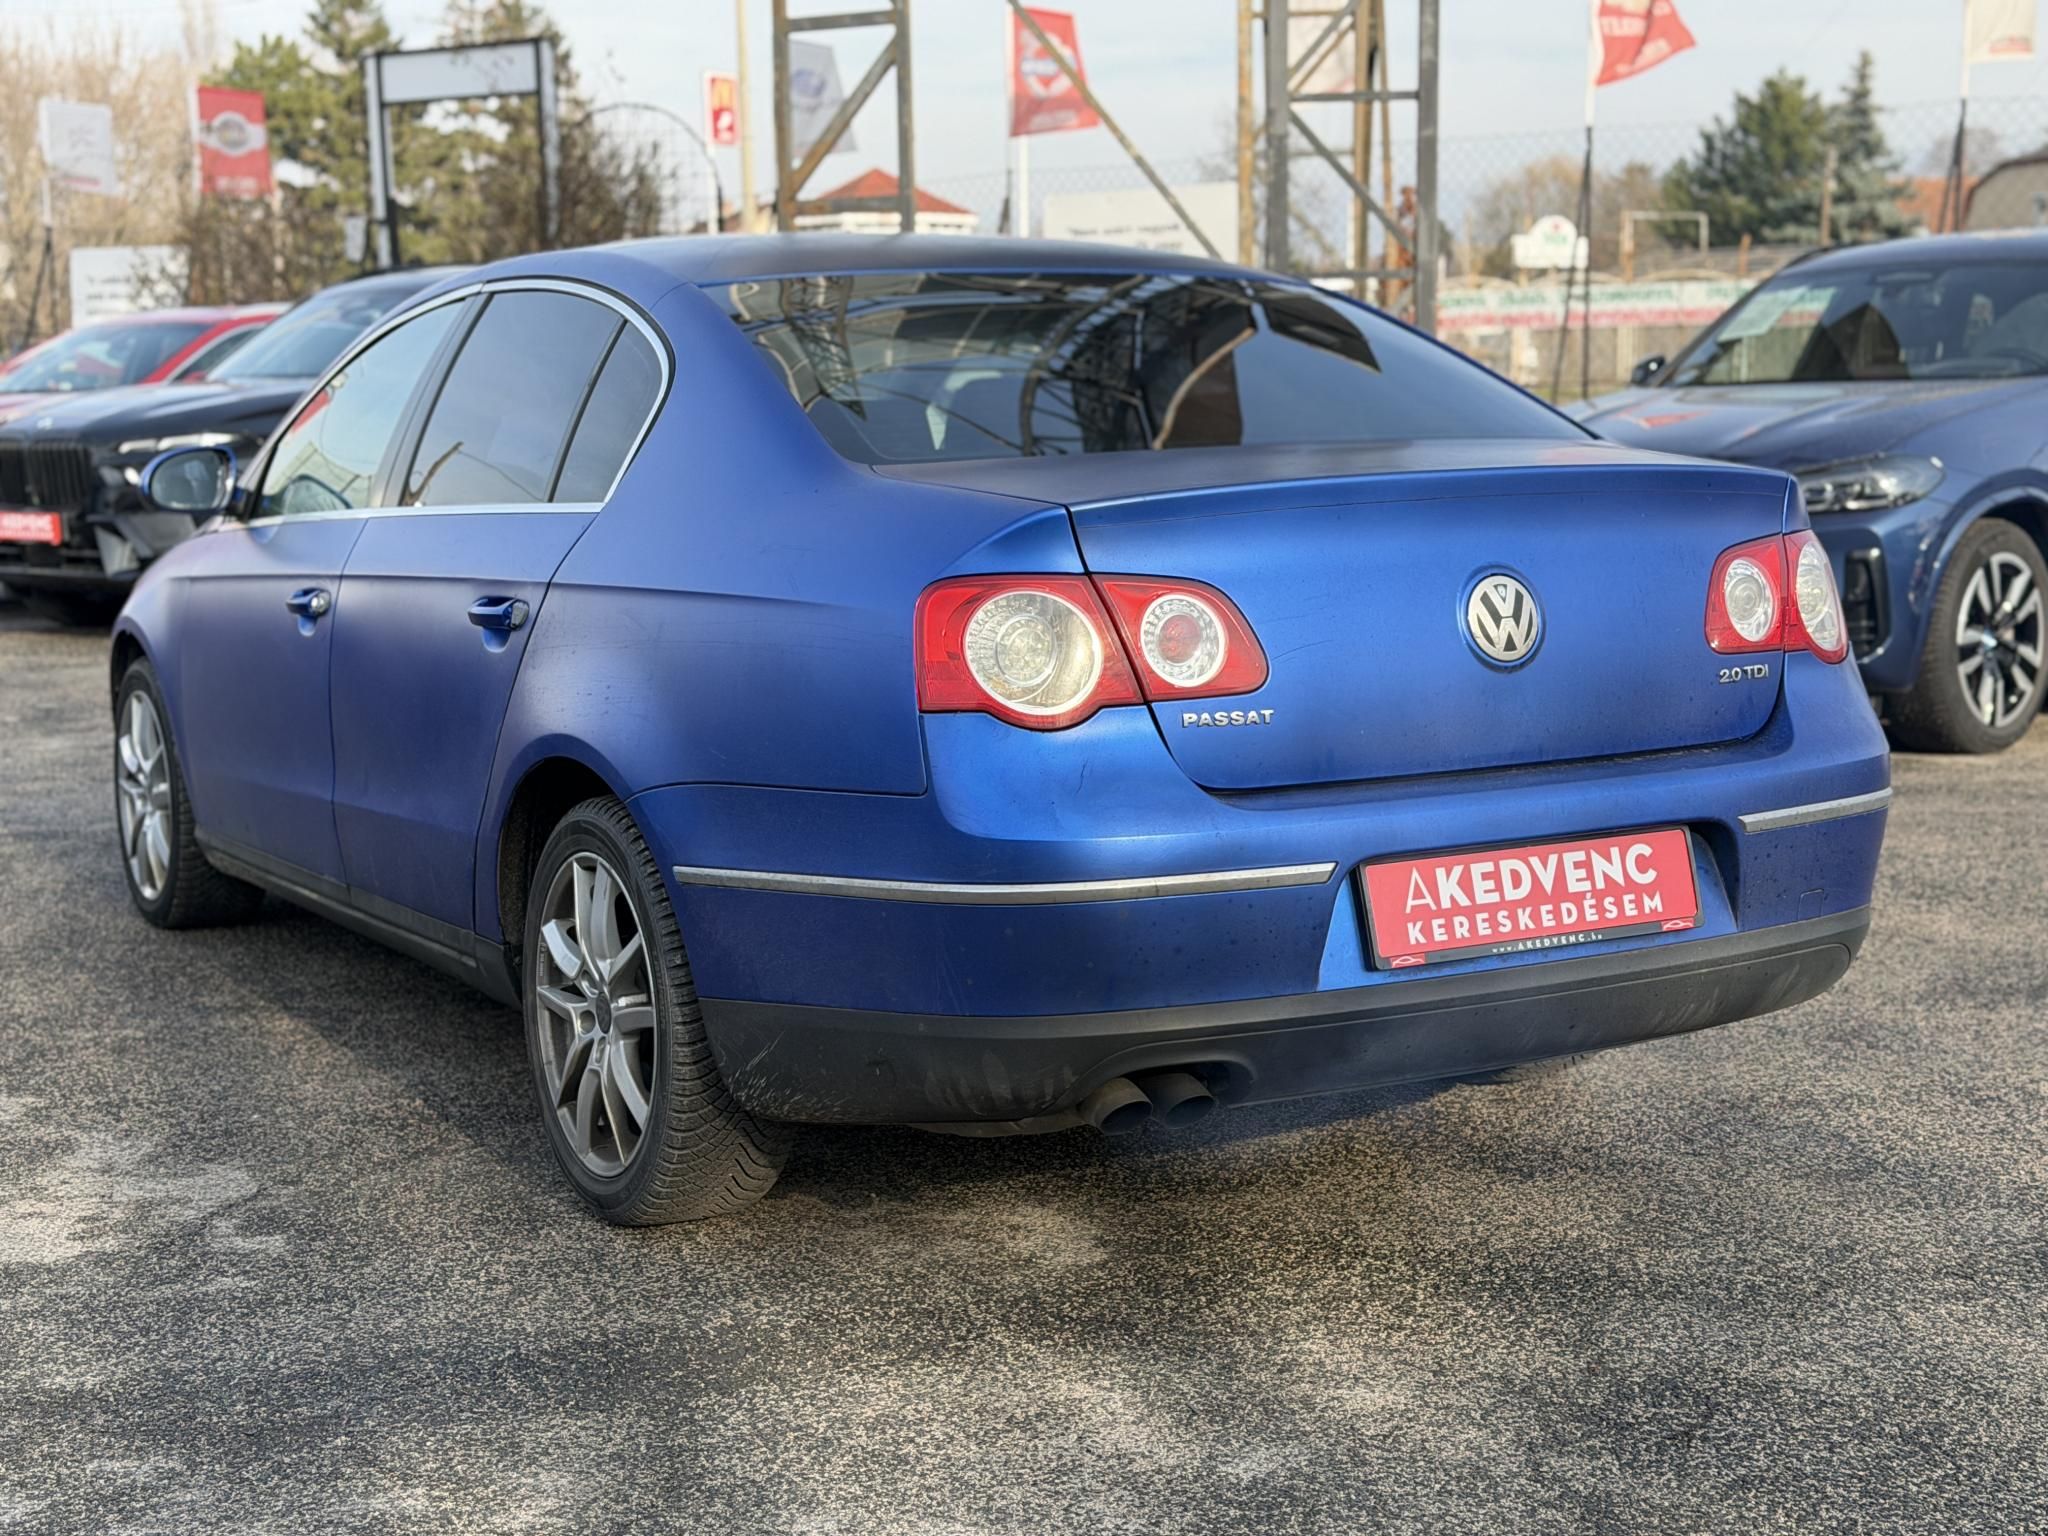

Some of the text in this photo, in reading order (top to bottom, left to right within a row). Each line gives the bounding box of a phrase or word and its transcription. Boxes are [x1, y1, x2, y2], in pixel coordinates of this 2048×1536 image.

[1719, 663, 1769, 683] 2.0 TDI
[1182, 709, 1275, 728] PASSAT
[1405, 843, 1658, 914] AKEDVENC
[1407, 890, 1664, 945] KERESKEDÉSEM
